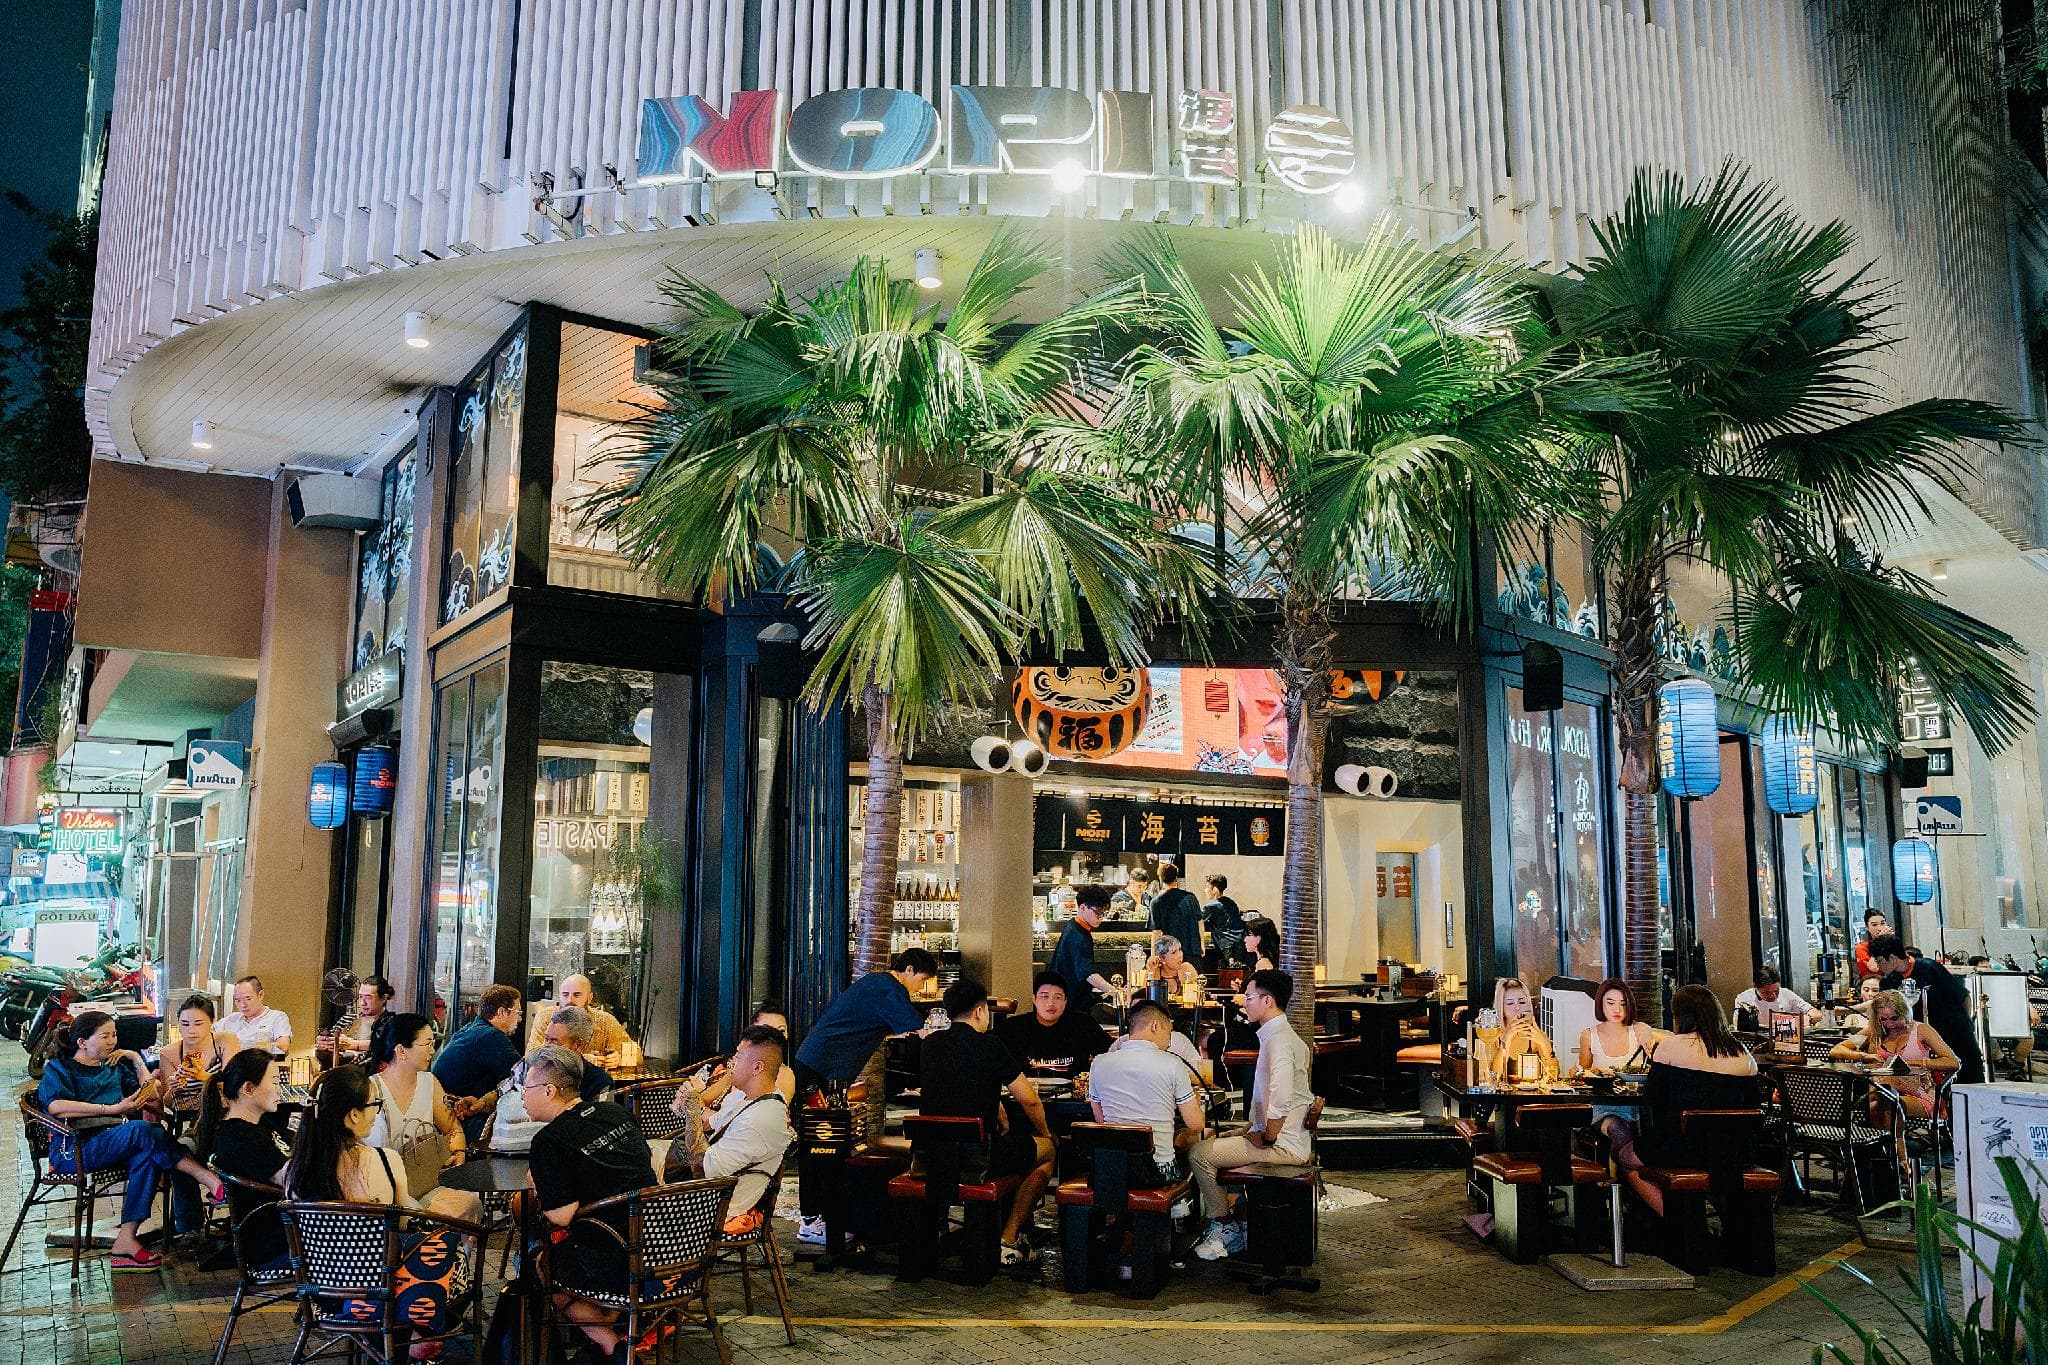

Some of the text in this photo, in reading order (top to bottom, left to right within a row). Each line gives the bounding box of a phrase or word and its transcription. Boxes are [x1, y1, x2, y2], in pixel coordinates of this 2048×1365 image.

[636, 84, 1154, 182] NORI
[1056, 715, 1104, 752] 福
[194, 773, 236, 785] LAVAZZA
[1798, 745, 1816, 795] NORI
[56, 829, 119, 852] HOTEL
[1075, 827, 1111, 839] NORI
